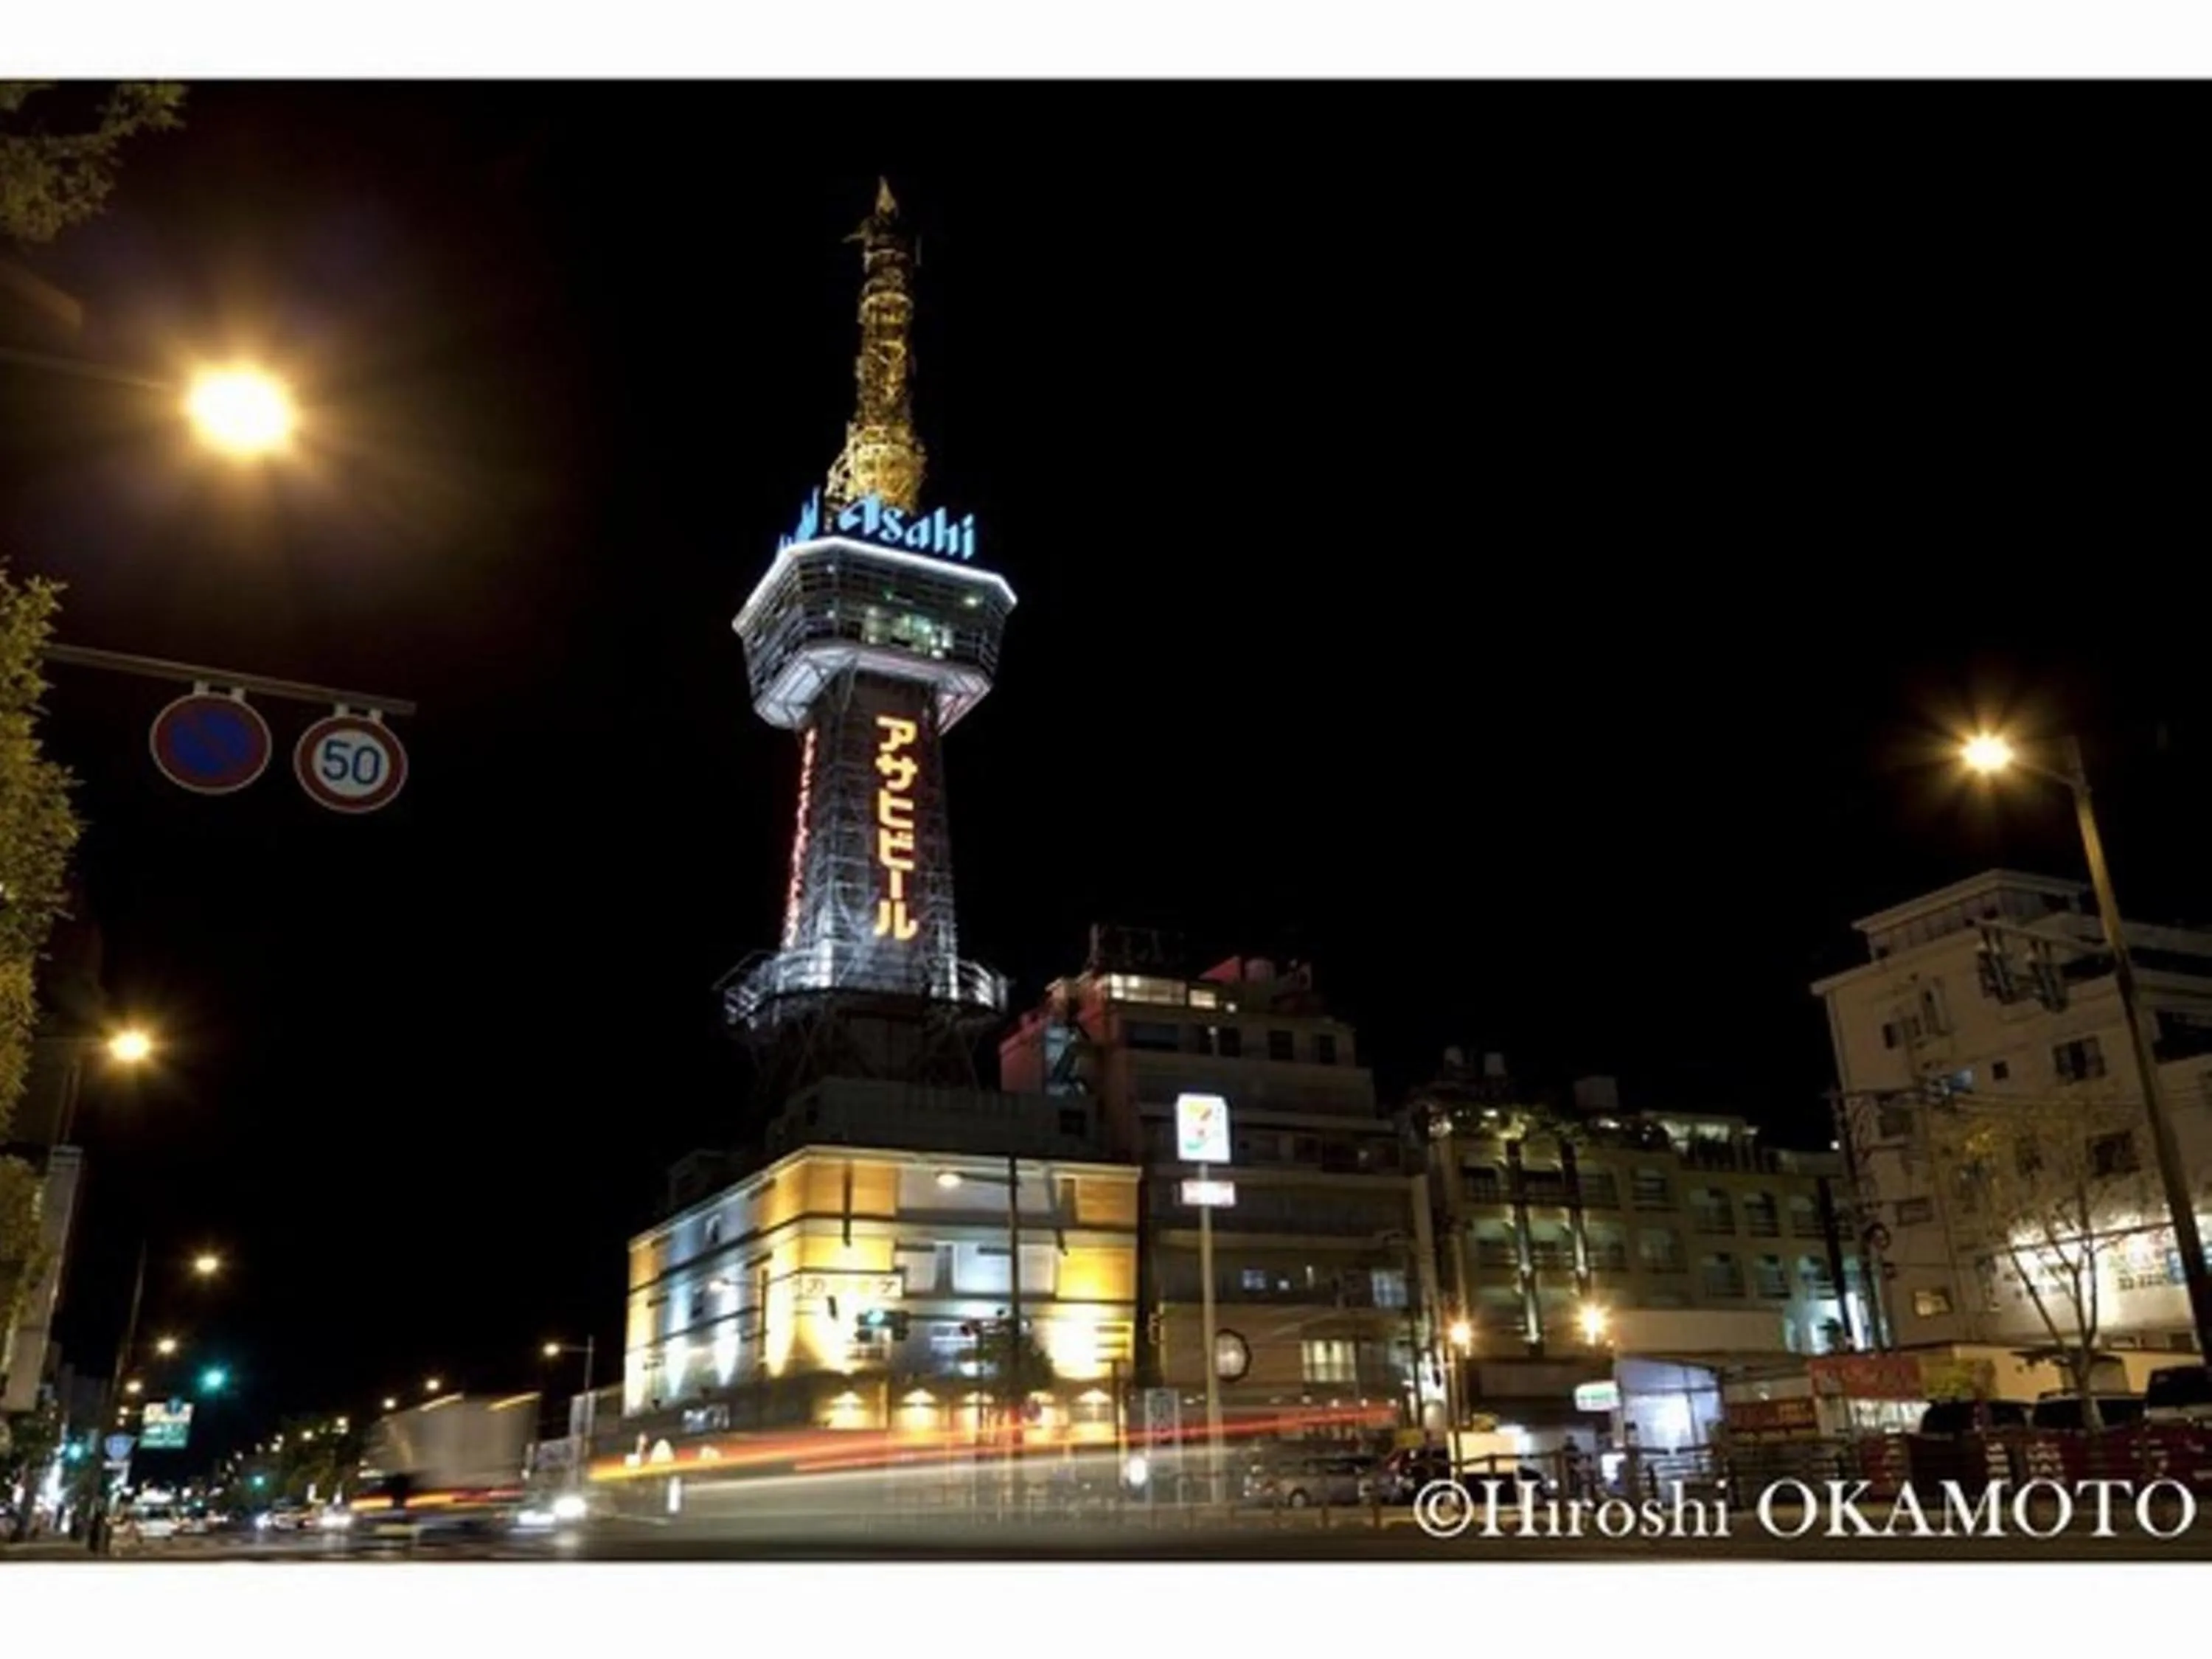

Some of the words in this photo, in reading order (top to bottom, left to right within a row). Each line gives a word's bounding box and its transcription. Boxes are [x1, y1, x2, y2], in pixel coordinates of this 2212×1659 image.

[838, 495, 975, 560] Asahi
[322, 740, 382, 785] 50
[874, 716, 918, 941] アサヒビール
